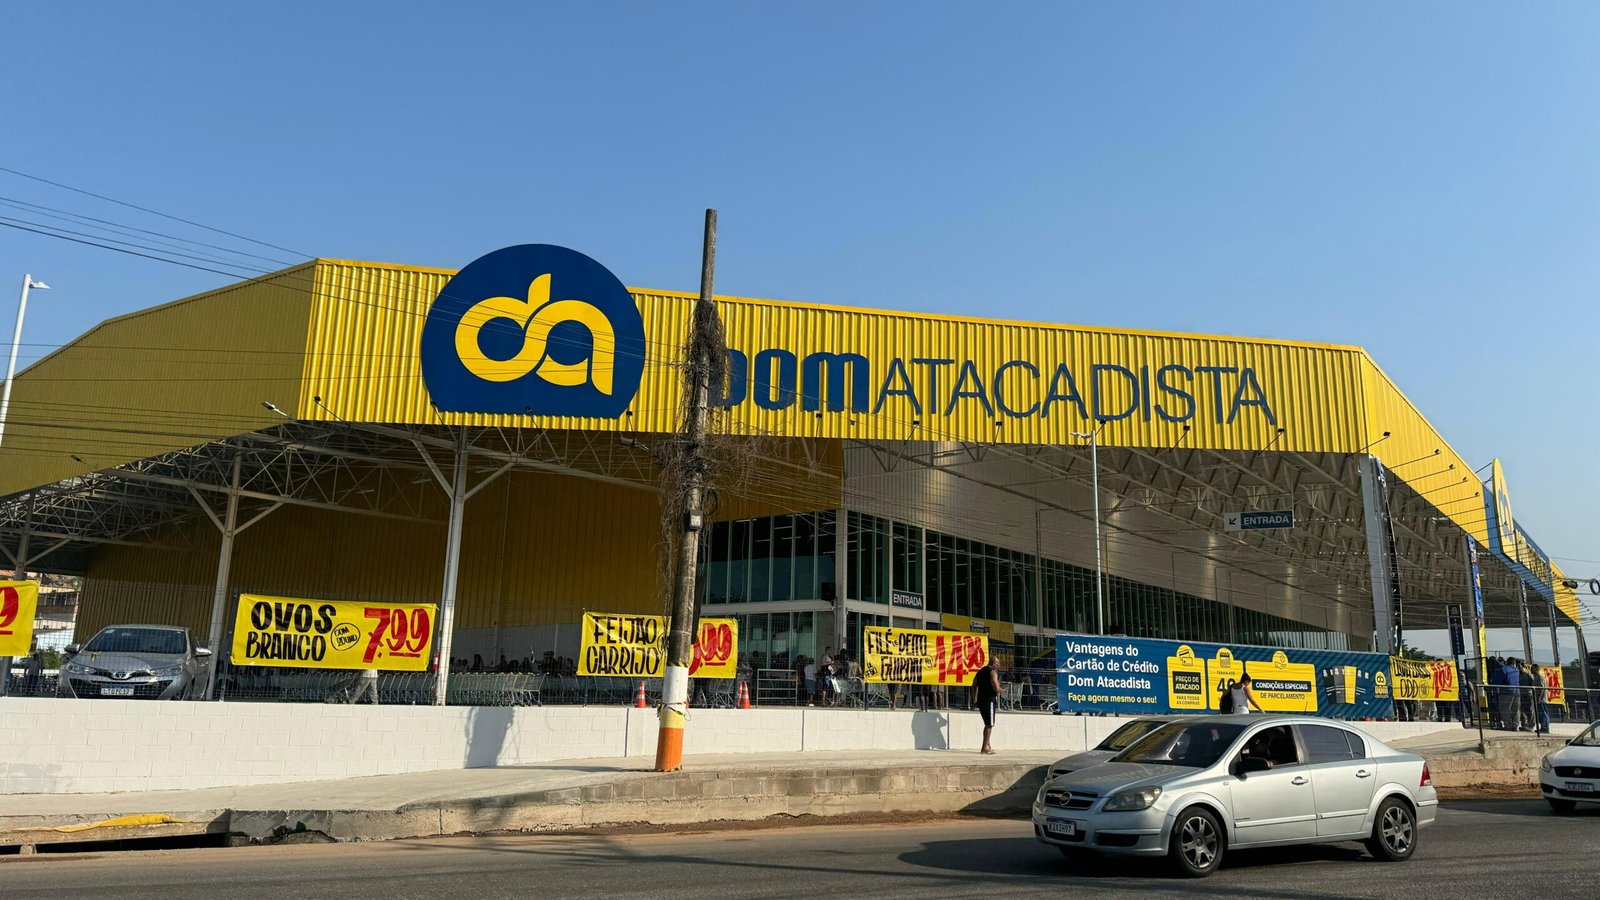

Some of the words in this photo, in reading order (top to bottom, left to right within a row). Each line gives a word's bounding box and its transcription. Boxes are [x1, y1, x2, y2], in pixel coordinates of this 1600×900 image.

[873, 357, 1277, 426] ATACADISTA
[1243, 515, 1290, 526] ENTRADA
[893, 593, 922, 607] ENTRADA
[250, 601, 337, 634] OVOS
[245, 631, 327, 661] BRANCO
[1065, 641, 1124, 657] Vantagens
[1125, 645, 1139, 657] do
[586, 645, 661, 675] CARRIJO
[1066, 657, 1104, 671] Cartão
[1107, 659, 1119, 671] de
[1122, 660, 1159, 674] Crédito
[1068, 674, 1094, 687] Dom
[1096, 676, 1151, 690] Atacadista
[1175, 675, 1191, 684] PREÇO
[1191, 675, 1200, 683] DE
[1175, 683, 1200, 691] ATACADO
[1255, 681, 1284, 691] CONDIÇÕES
[1284, 682, 1309, 691] ESPECIAIS
[1068, 692, 1086, 703] Faça
[1087, 694, 1109, 704] agora
[1110, 695, 1135, 703] mesmo
[1143, 695, 1157, 704] seu!
